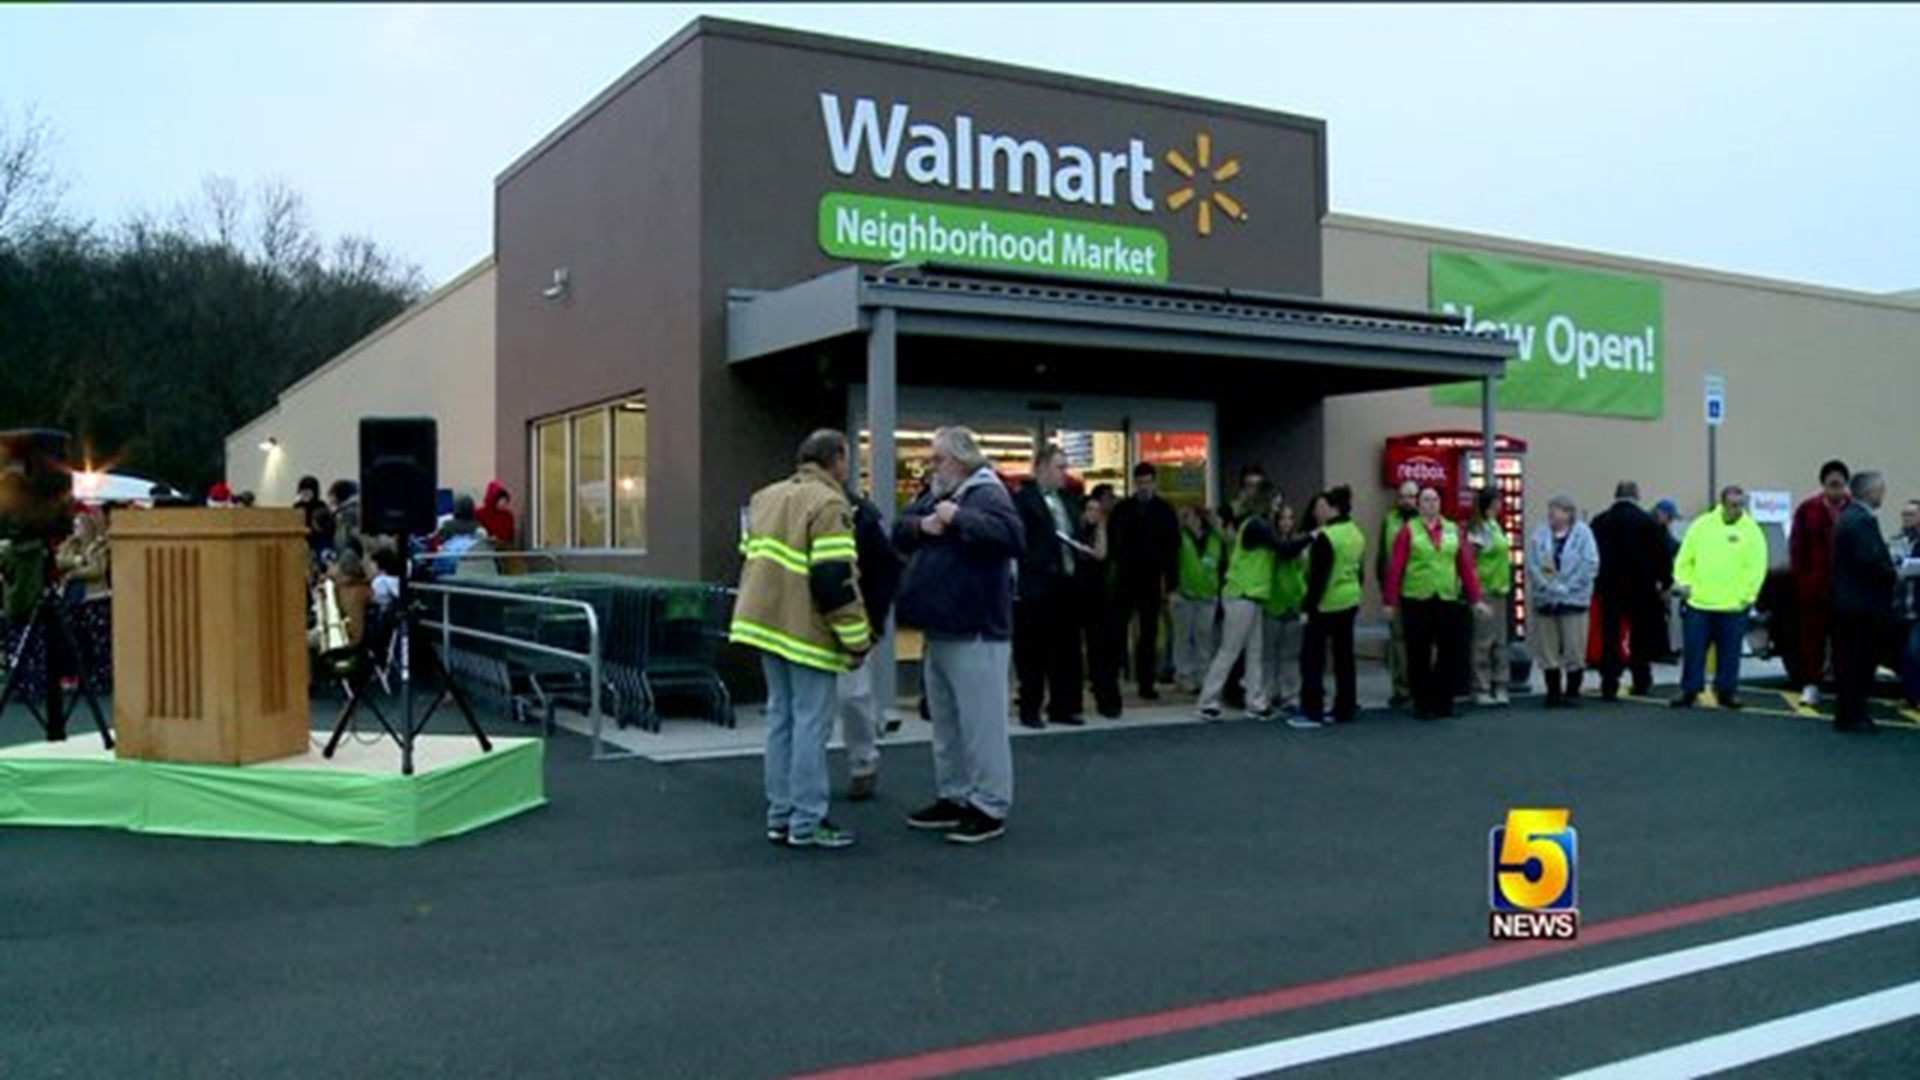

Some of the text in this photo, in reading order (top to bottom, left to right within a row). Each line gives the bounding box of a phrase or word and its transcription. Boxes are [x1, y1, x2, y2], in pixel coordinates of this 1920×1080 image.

[819, 92, 1155, 212] Walmart
[835, 207, 1156, 276] Neighborhood Market
[1545, 315, 1655, 379] Open!
[1397, 463, 1447, 481] redbox
